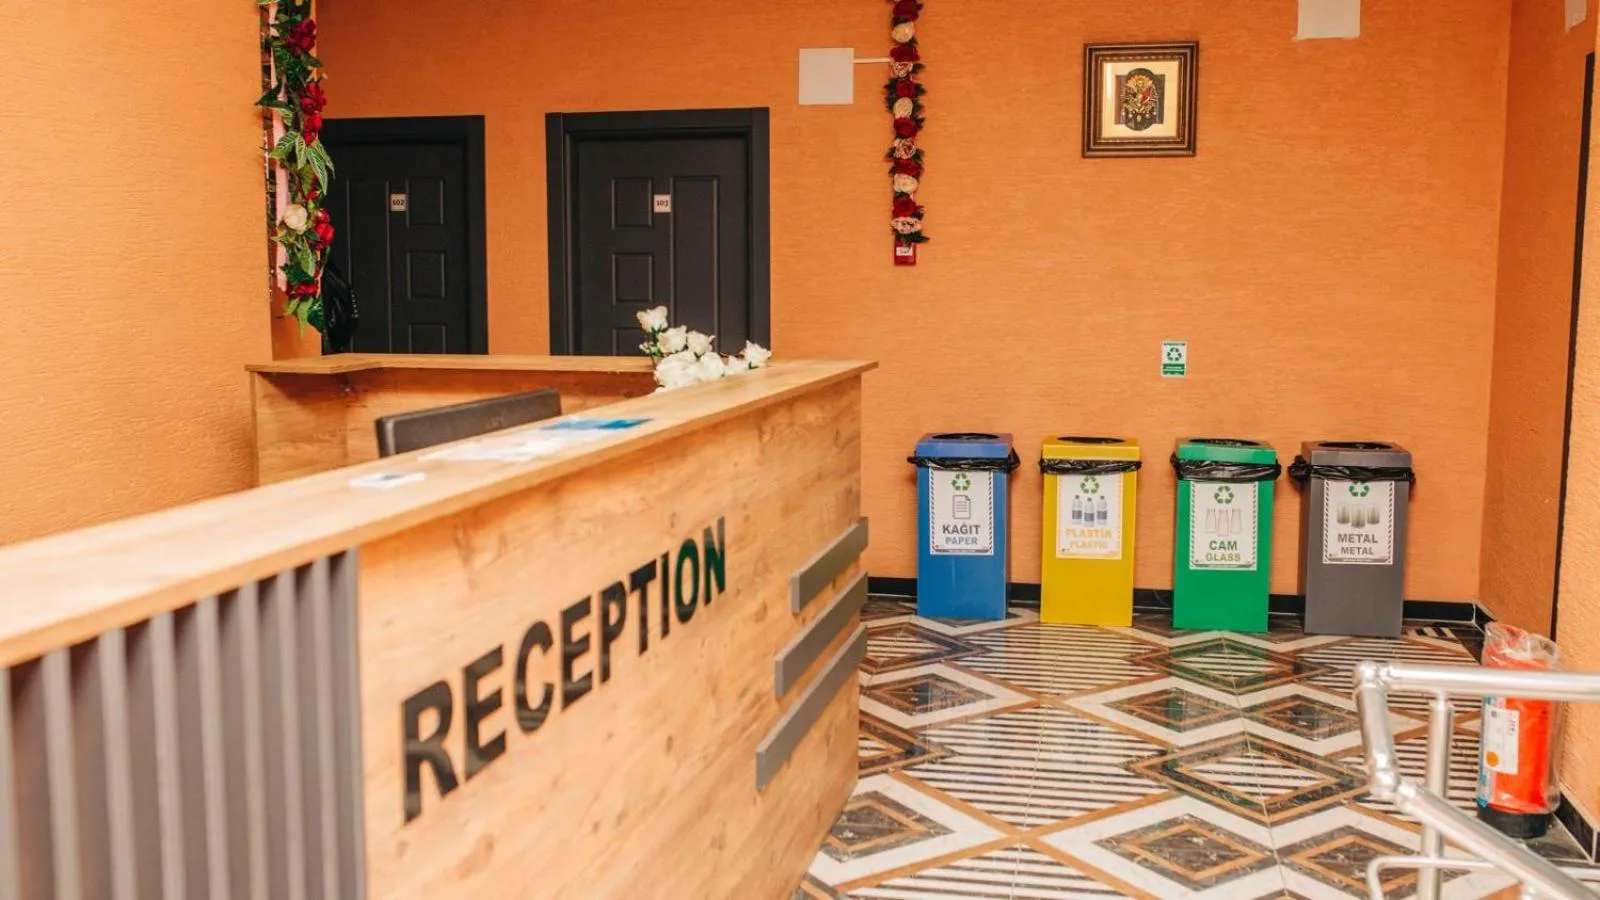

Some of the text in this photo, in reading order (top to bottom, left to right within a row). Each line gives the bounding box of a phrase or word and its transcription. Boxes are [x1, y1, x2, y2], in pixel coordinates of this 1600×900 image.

[942, 522, 981, 534] KAĞIT
[945, 536, 978, 546] PAPER
[1337, 533, 1379, 544] METAL
[1209, 540, 1238, 551] CAM
[1340, 546, 1375, 556] METAL
[1205, 552, 1241, 562] GLASS
[401, 516, 726, 827] RECEPTION
